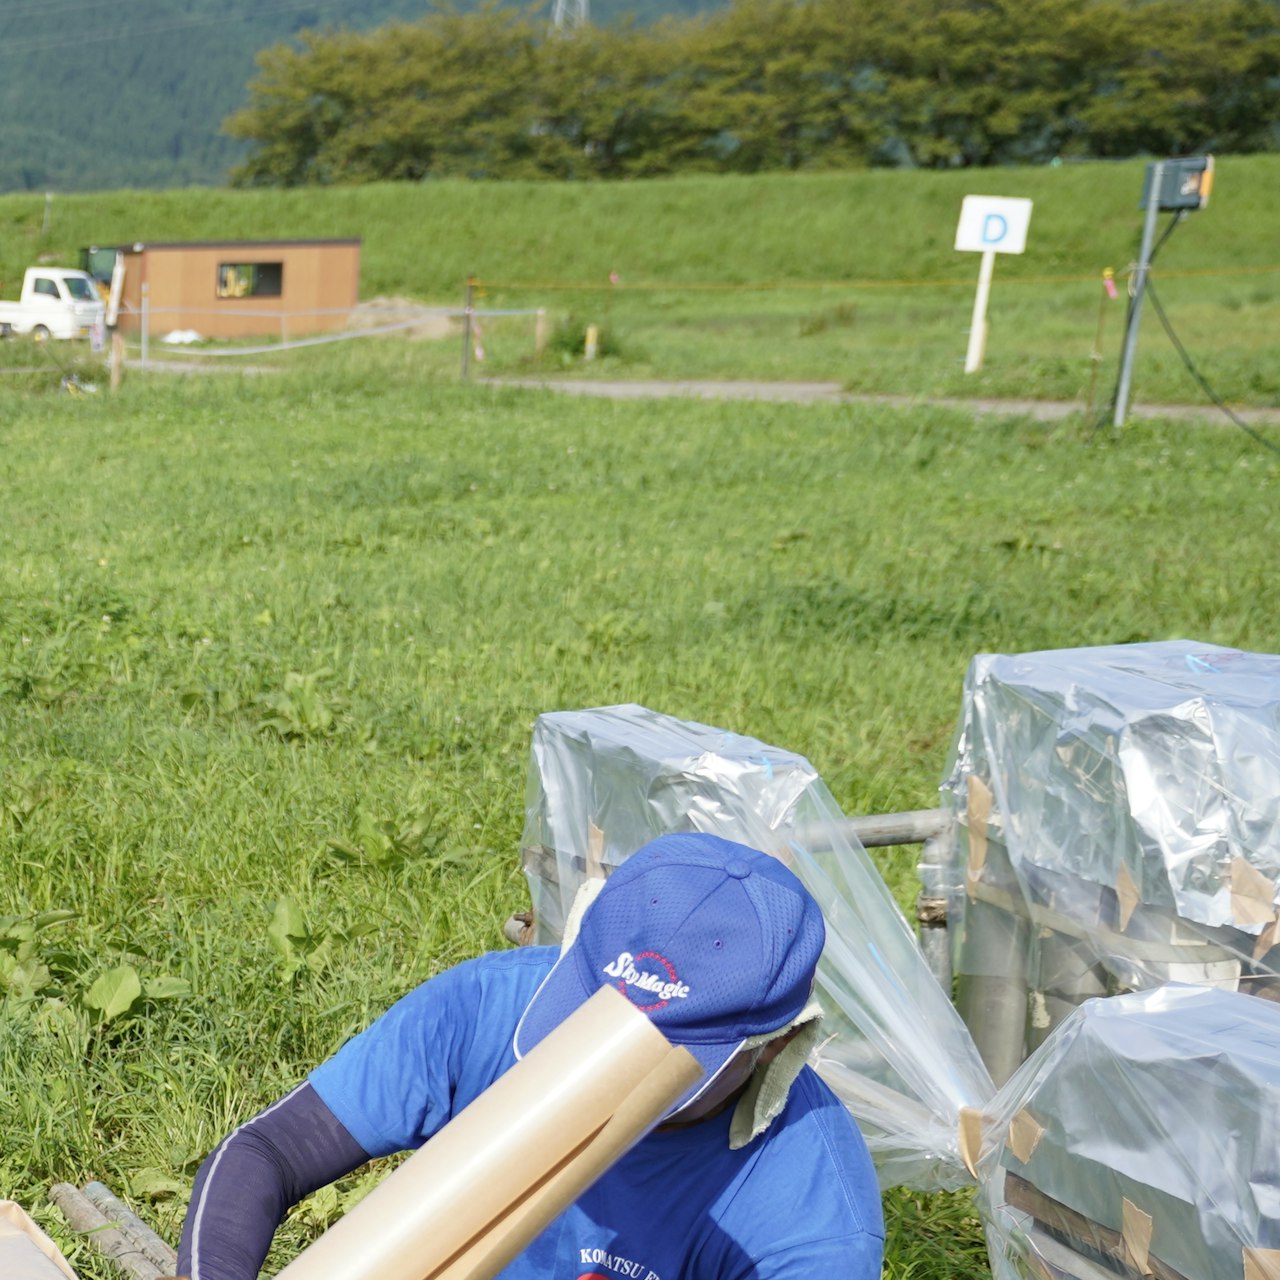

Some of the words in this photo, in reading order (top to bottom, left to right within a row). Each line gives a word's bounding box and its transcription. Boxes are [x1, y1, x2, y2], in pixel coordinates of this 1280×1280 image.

[982, 213, 1009, 244] D
[603, 951, 691, 1000] SkyMagic
[580, 1248, 645, 1279] KOMATSU
